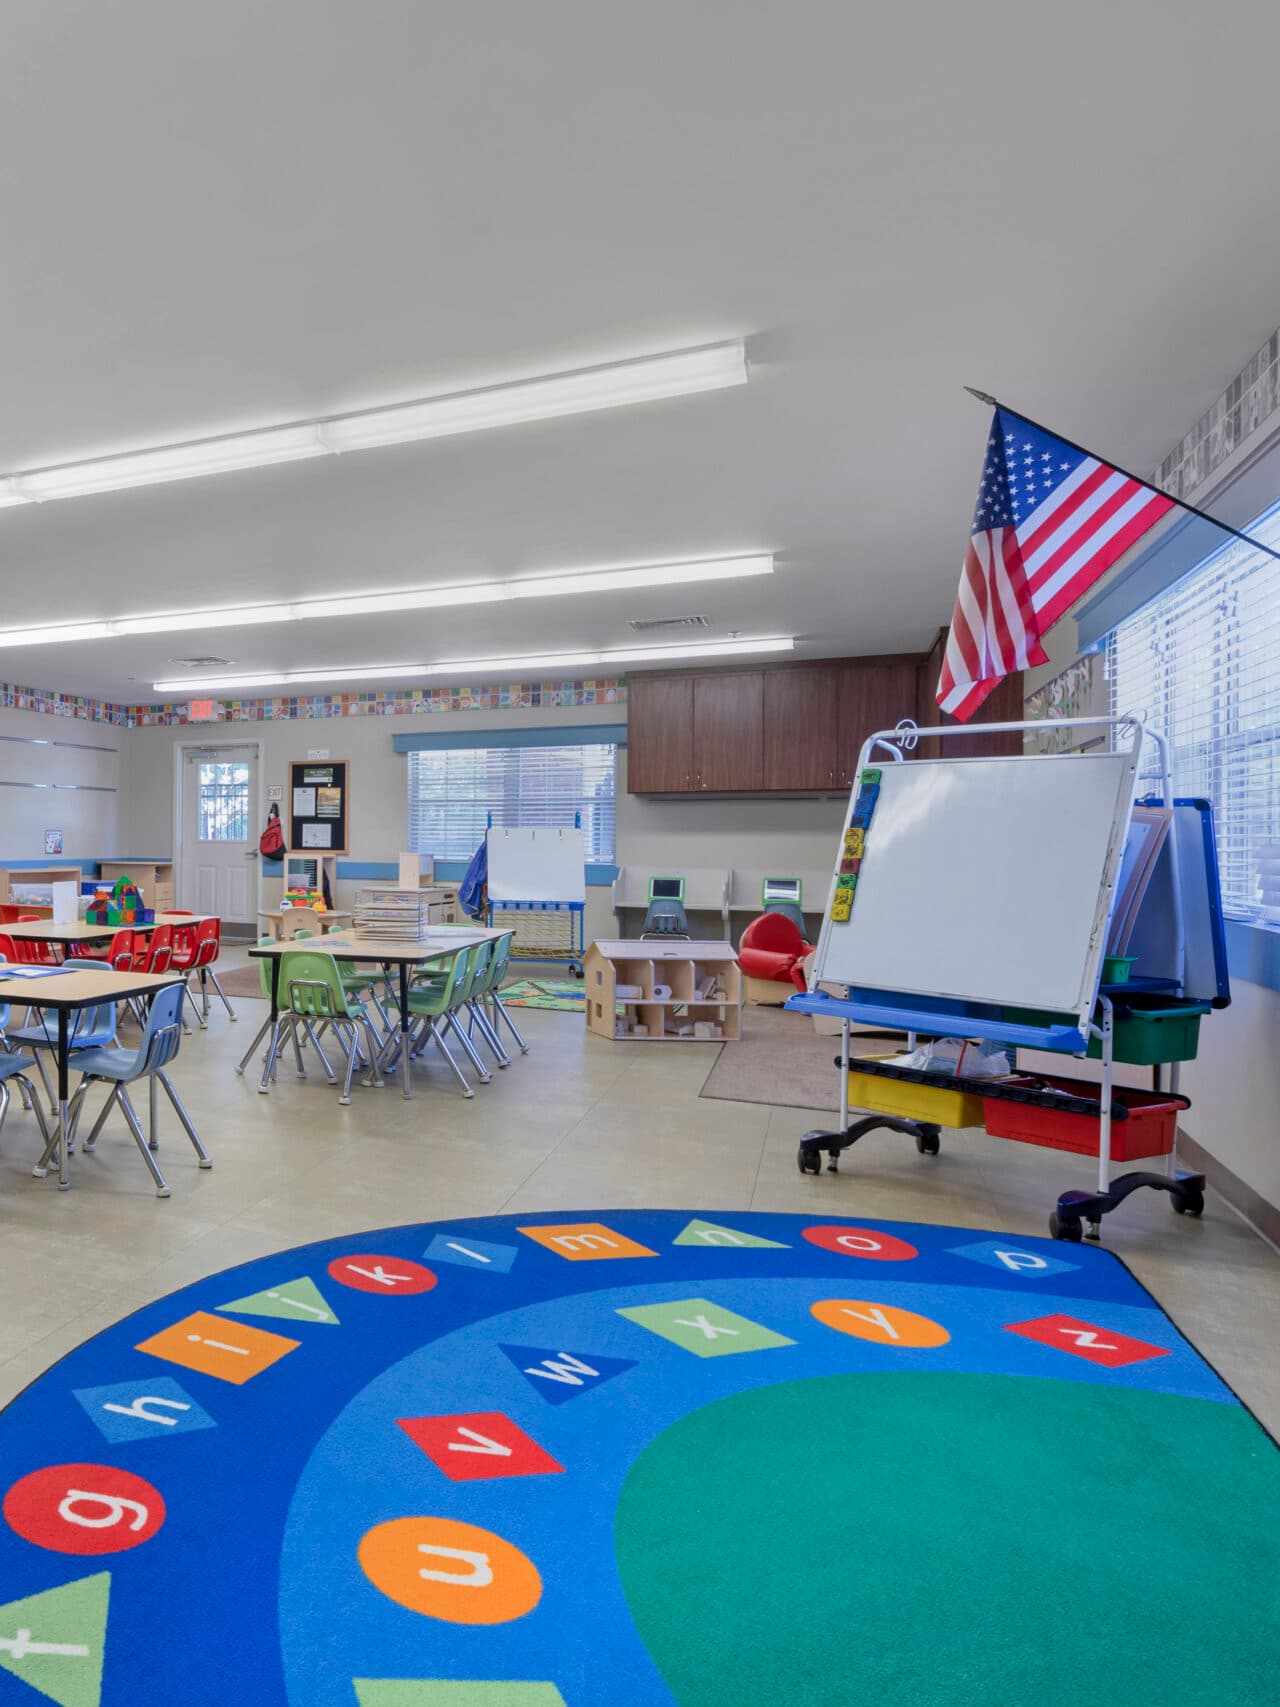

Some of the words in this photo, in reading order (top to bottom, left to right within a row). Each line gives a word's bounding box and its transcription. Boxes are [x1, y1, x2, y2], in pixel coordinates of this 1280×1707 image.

[192, 701, 213, 718] EXIT
[673, 1315, 740, 1340] x
[841, 1308, 901, 1339] y
[1058, 1328, 1118, 1350] z
[58, 1489, 148, 1531] g
[103, 1396, 190, 1426] h
[186, 1334, 249, 1356] i
[265, 1292, 329, 1321] j
[347, 1264, 411, 1286] k
[553, 1234, 618, 1251] m
[694, 1229, 746, 1245] n
[836, 1235, 882, 1251] o
[994, 1249, 1047, 1270] p
[524, 1352, 600, 1385] w
[448, 1427, 512, 1456] v
[418, 1544, 494, 1587] u
